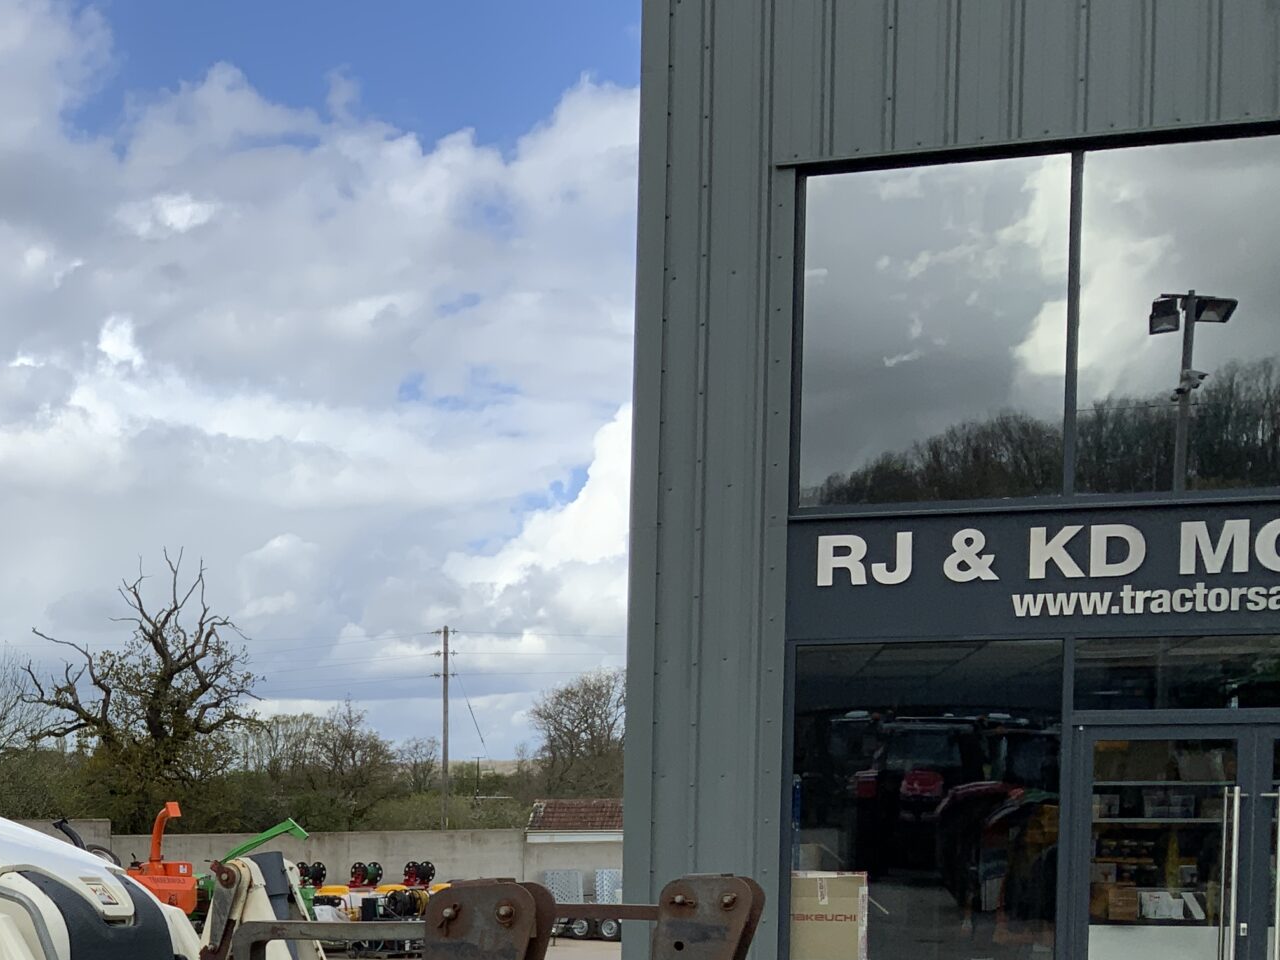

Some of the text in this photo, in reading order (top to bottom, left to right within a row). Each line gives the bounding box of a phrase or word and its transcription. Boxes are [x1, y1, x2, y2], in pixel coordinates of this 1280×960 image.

[817, 531, 913, 587] RJ
[943, 528, 1000, 583] &
[1029, 523, 1147, 580] KD
